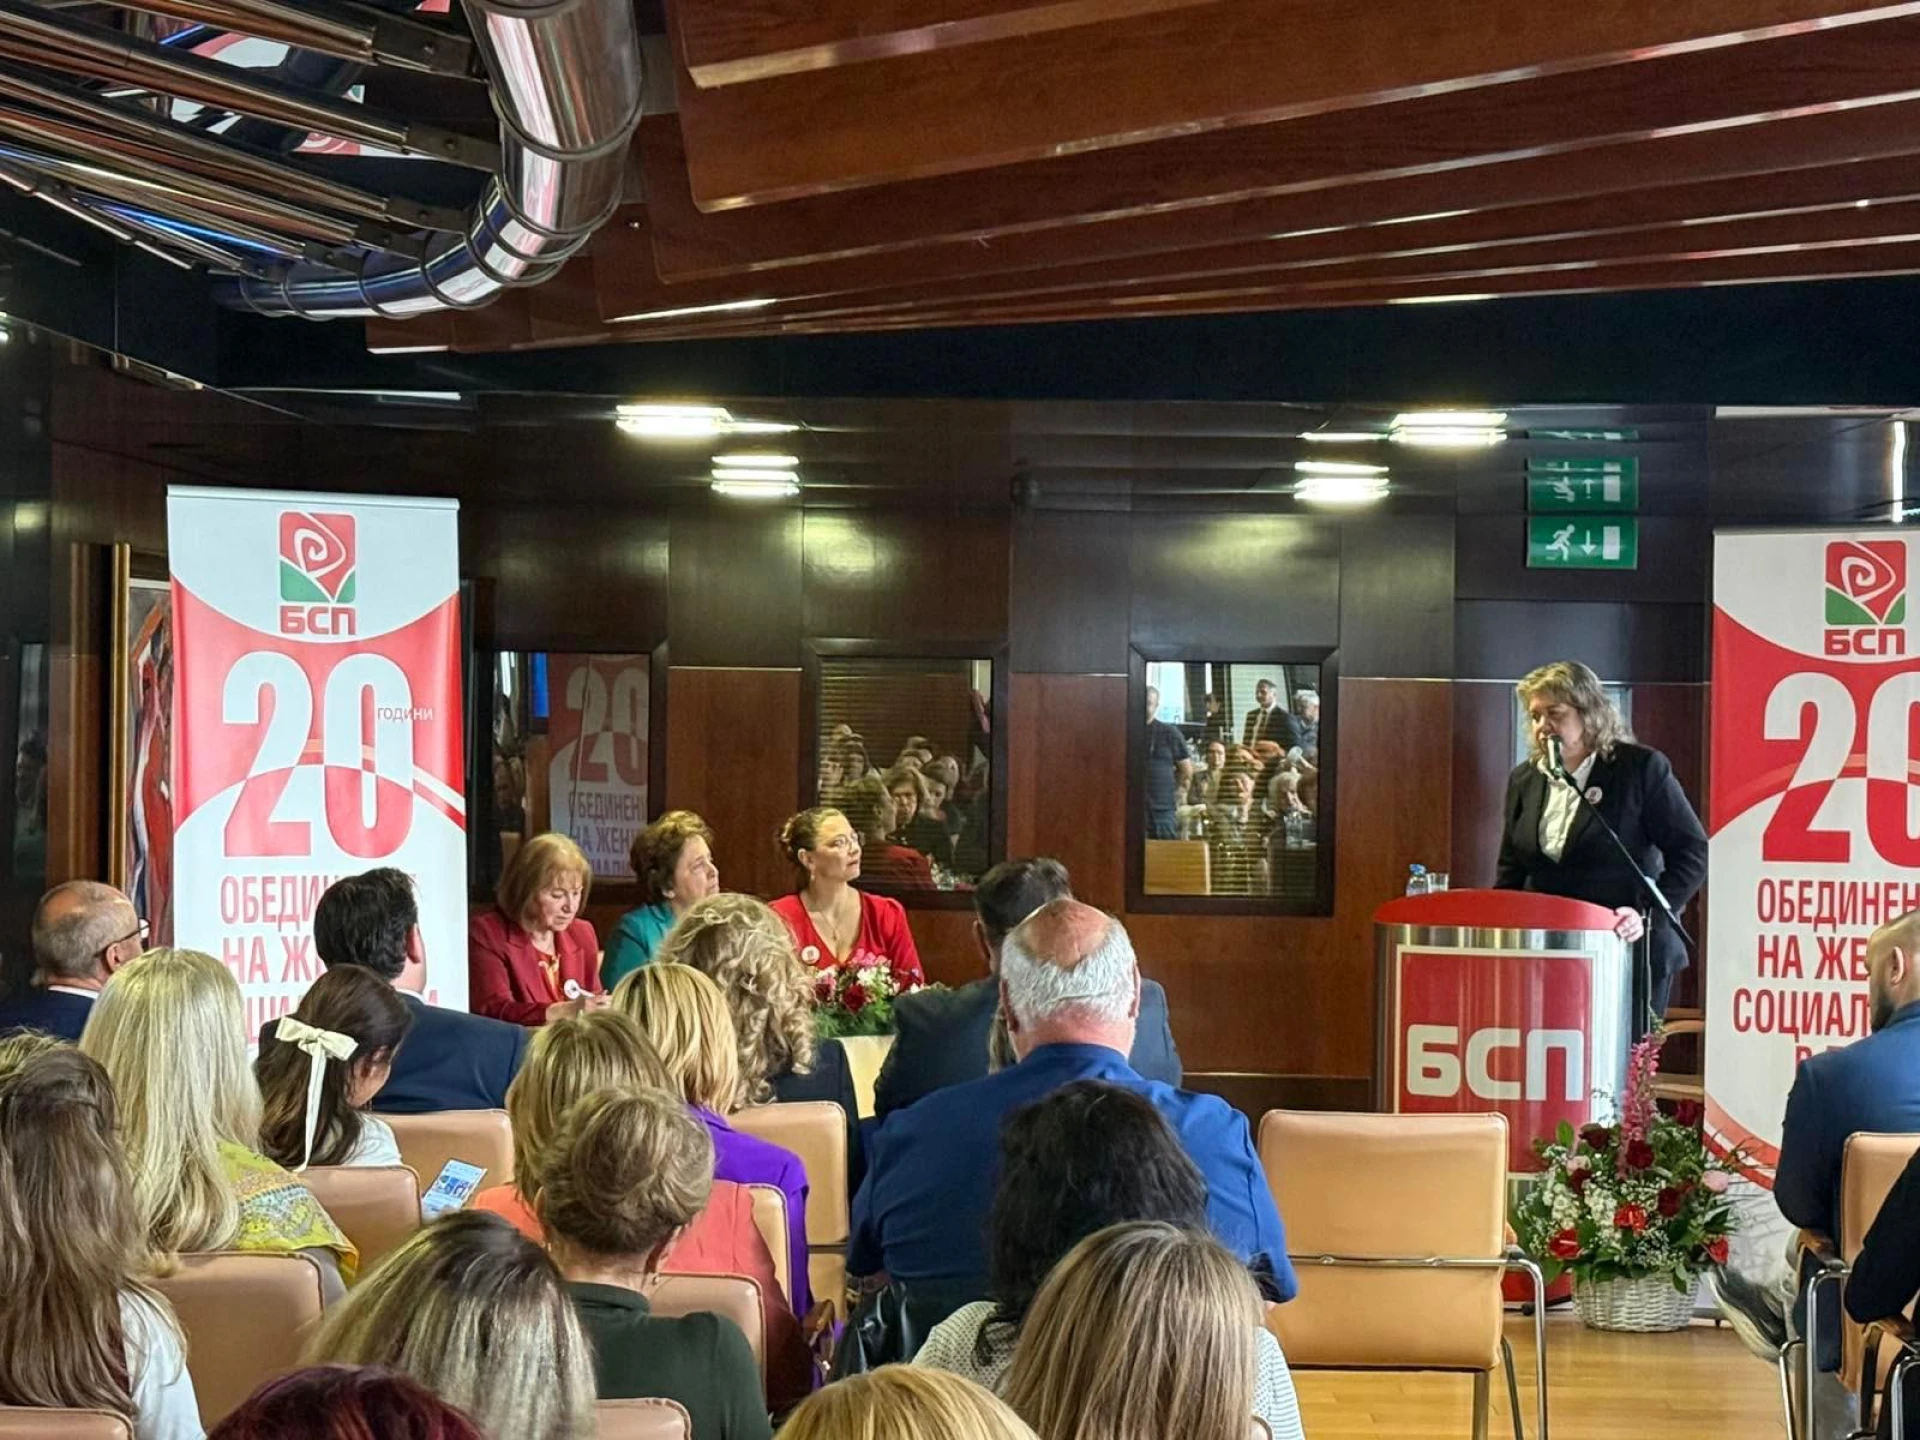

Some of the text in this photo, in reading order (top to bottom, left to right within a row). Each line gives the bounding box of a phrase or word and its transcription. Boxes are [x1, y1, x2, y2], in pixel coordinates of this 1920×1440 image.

[280, 605, 356, 635] БСП
[1824, 629, 1905, 655] БСП
[377, 707, 433, 723] ГОДИНИ
[222, 650, 415, 858] 20
[1763, 671, 1920, 868] 20
[220, 875, 340, 932] ОБЕДИ
[222, 935, 270, 983] НА
[1757, 934, 1804, 979] НА
[1733, 988, 1869, 1043] СОЦИАЛ
[1406, 1024, 1584, 1101] БСП
